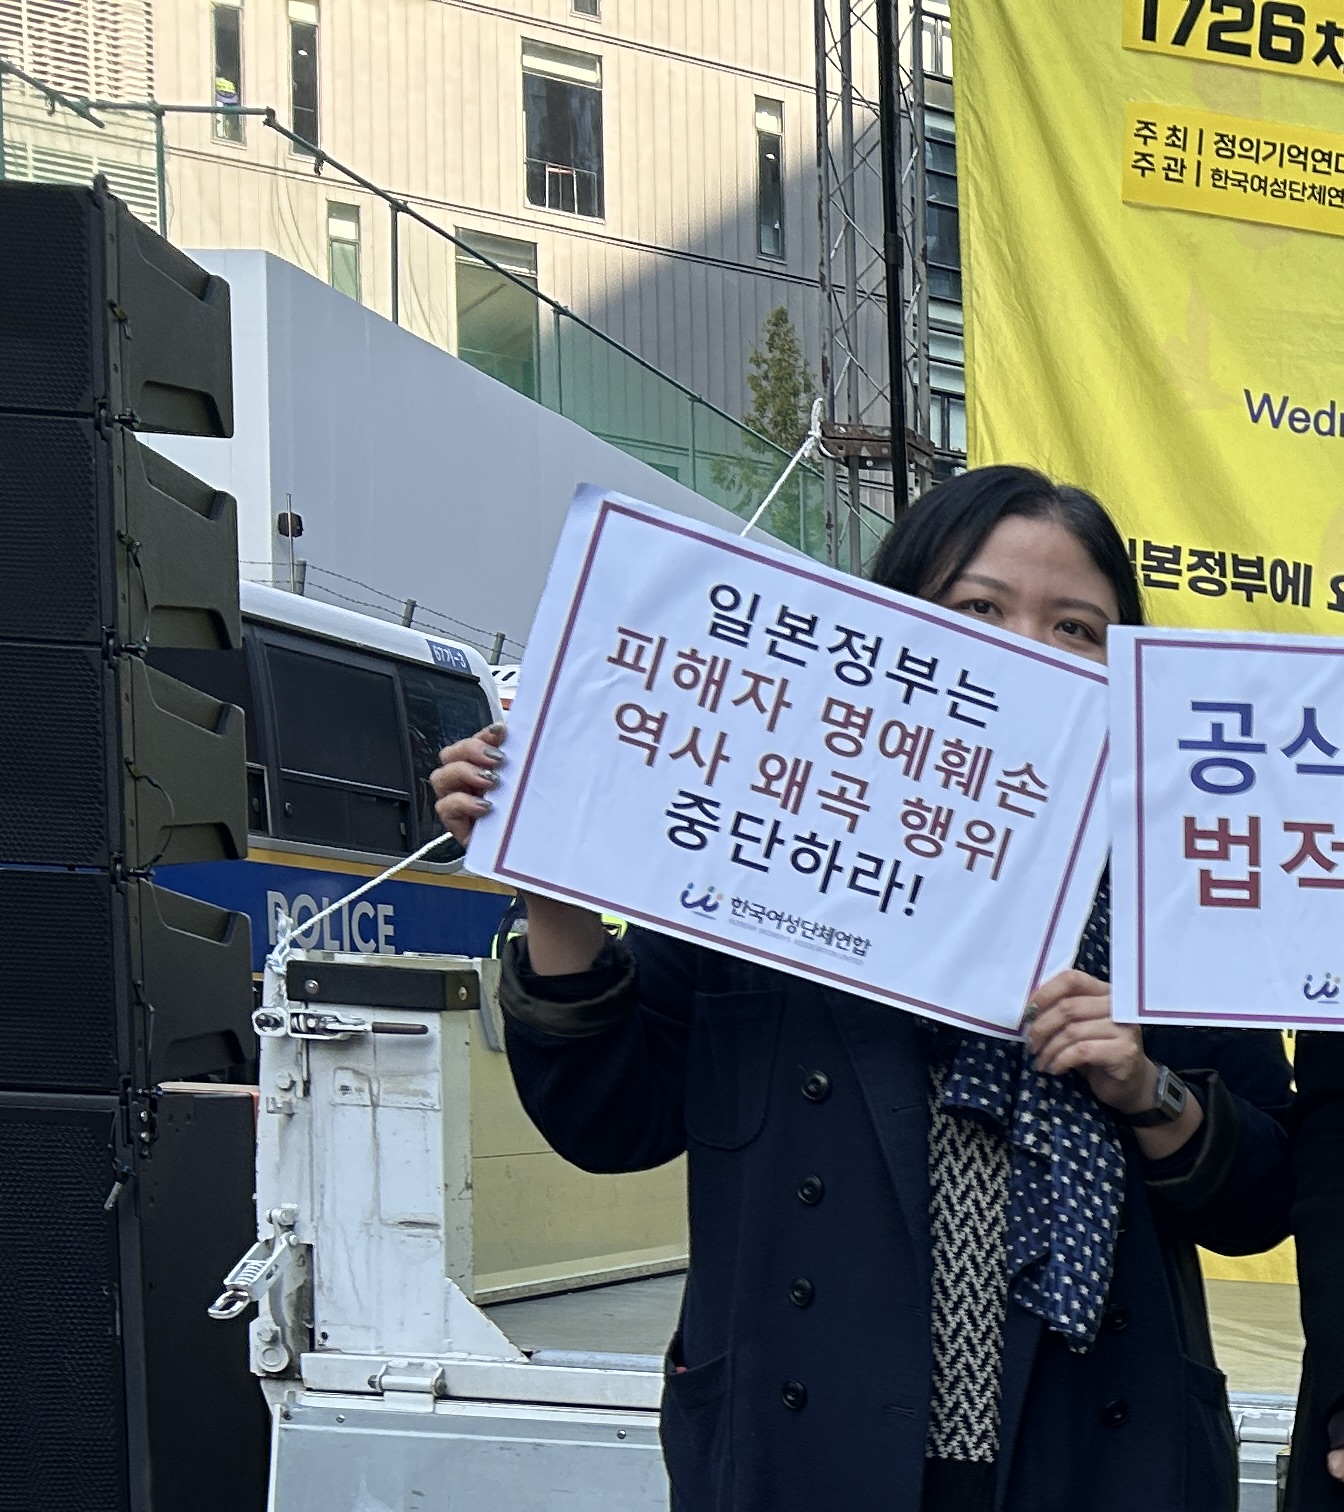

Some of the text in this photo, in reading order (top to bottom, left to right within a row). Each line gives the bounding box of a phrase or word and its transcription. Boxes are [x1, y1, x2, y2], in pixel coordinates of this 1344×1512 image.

[1125, 537, 1313, 608] 본정부에
[708, 583, 1000, 728] 일본정부는
[606, 625, 1051, 819] 피해자 명예훼손
[614, 701, 1013, 883] 역사 왜곡 행위
[664, 787, 924, 919] 중단하라!
[267, 890, 396, 954] POLICE
[730, 896, 873, 957] 한국여성단체연합
